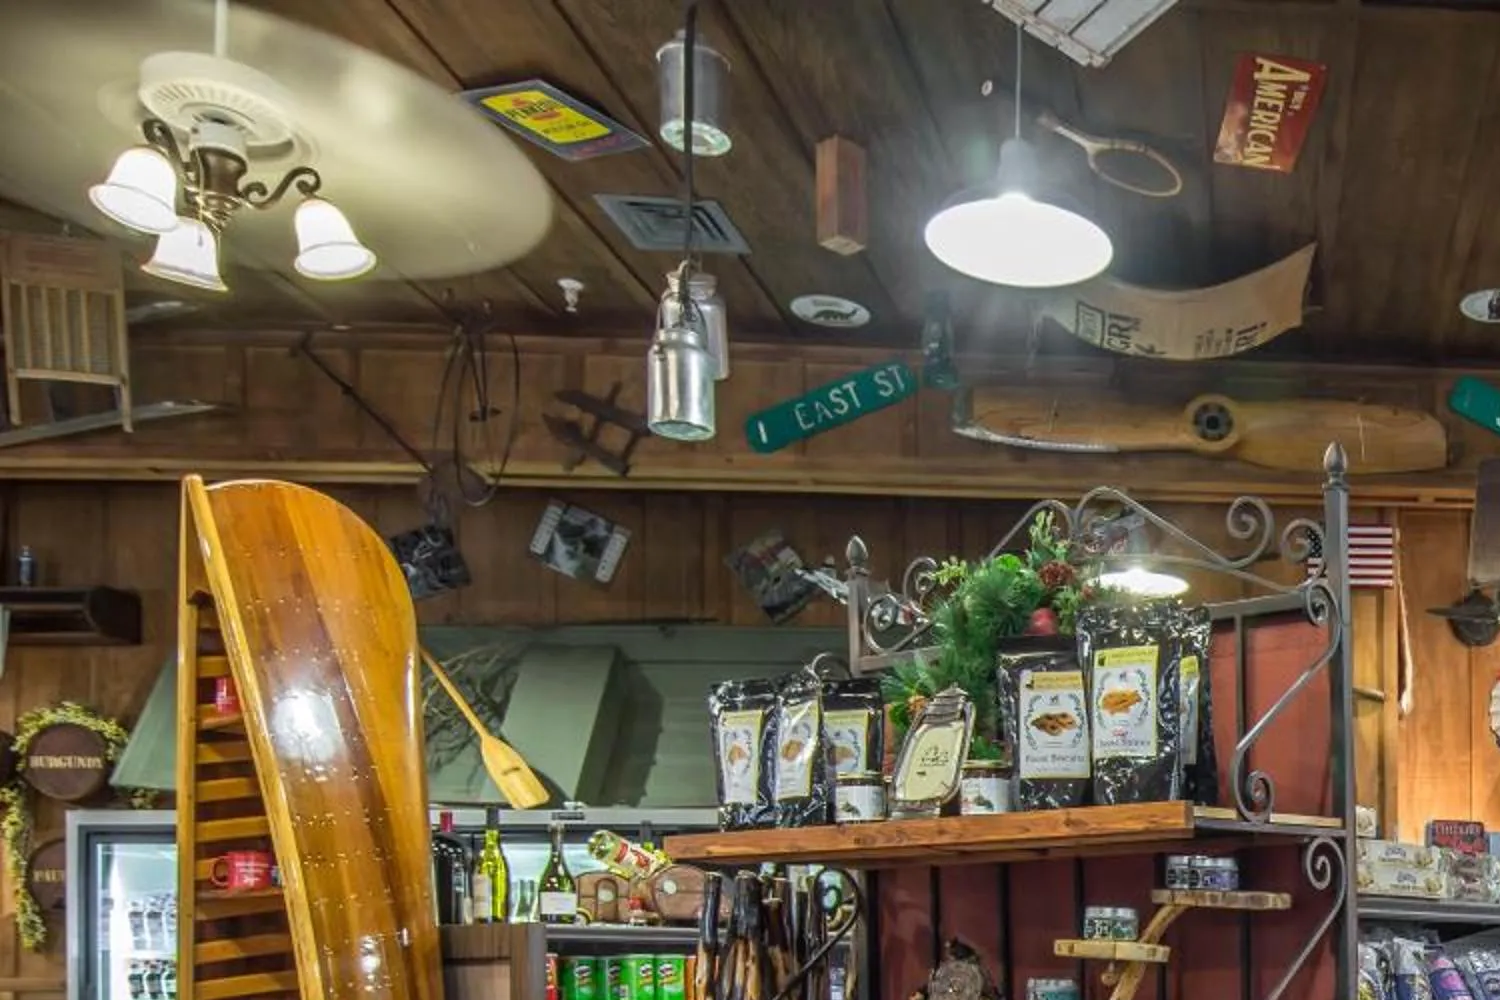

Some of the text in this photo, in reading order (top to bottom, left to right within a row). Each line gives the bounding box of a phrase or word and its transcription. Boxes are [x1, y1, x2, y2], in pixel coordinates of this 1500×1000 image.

[1242, 56, 1312, 169] AMERICAN
[793, 380, 862, 431] EAST
[873, 364, 906, 397] ST
